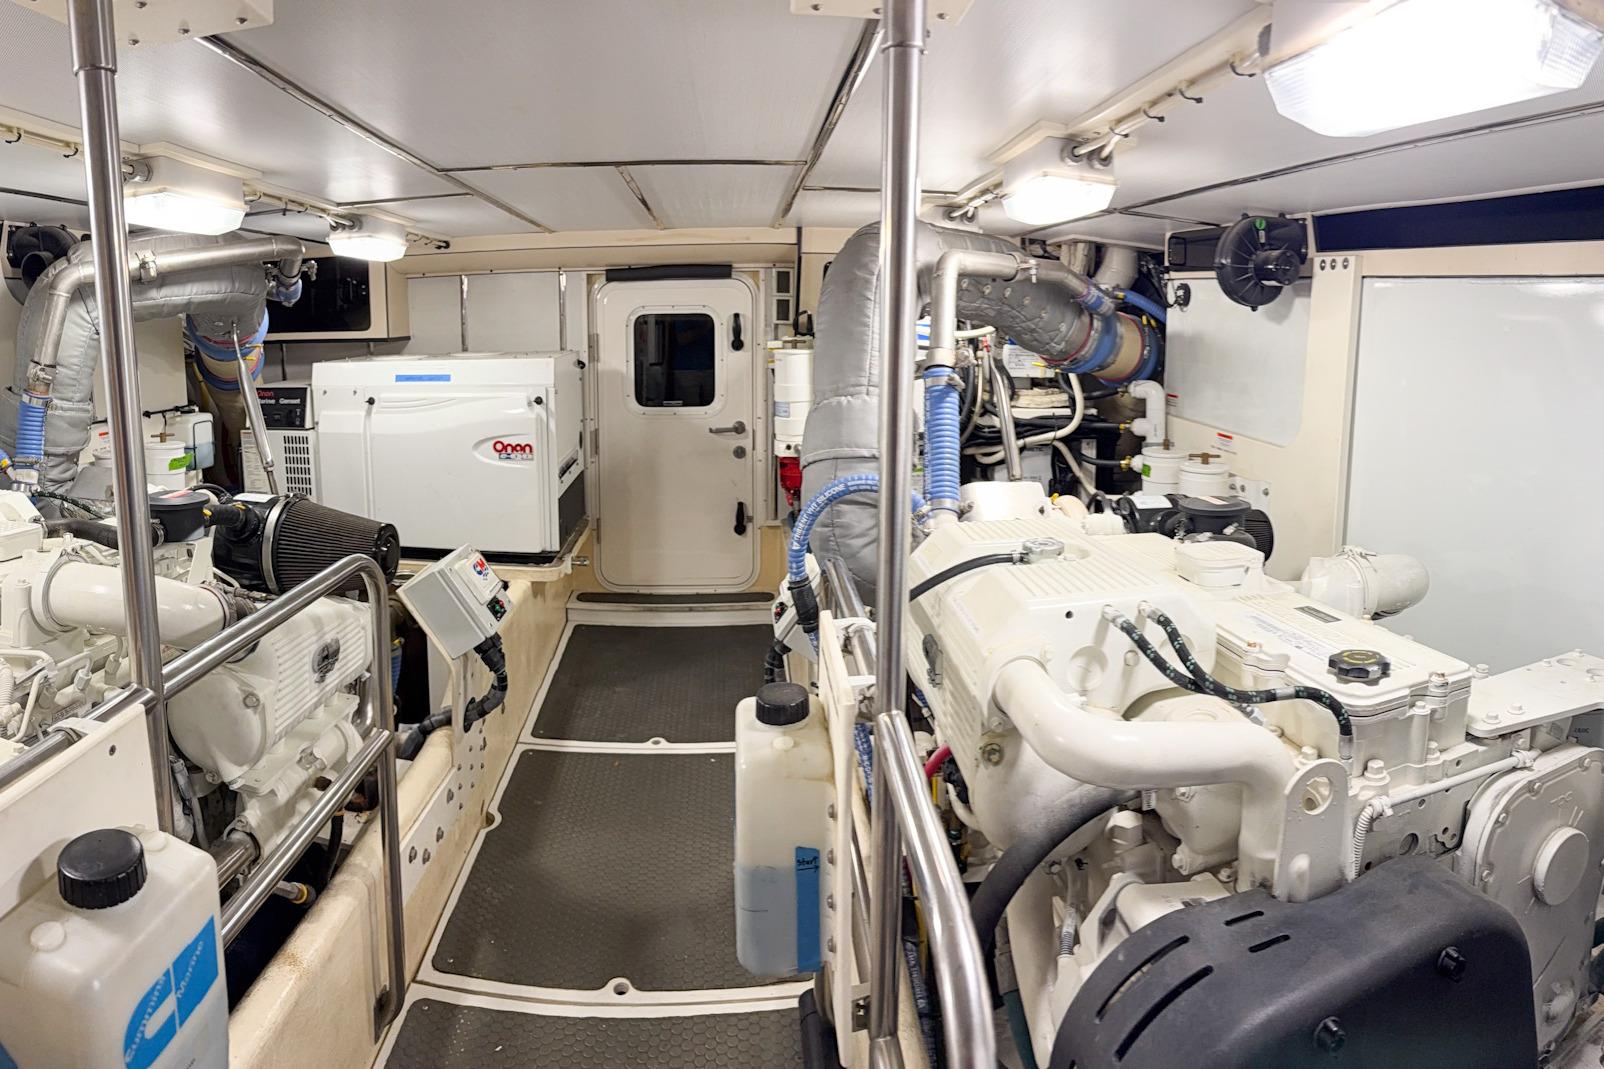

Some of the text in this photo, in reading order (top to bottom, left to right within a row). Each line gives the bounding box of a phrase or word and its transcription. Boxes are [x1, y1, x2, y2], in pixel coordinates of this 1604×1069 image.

[493, 440, 532, 454] Onan
[793, 514, 809, 541] TRIDENT
[816, 483, 846, 504] SILICONE
[177, 940, 205, 999] Marine
